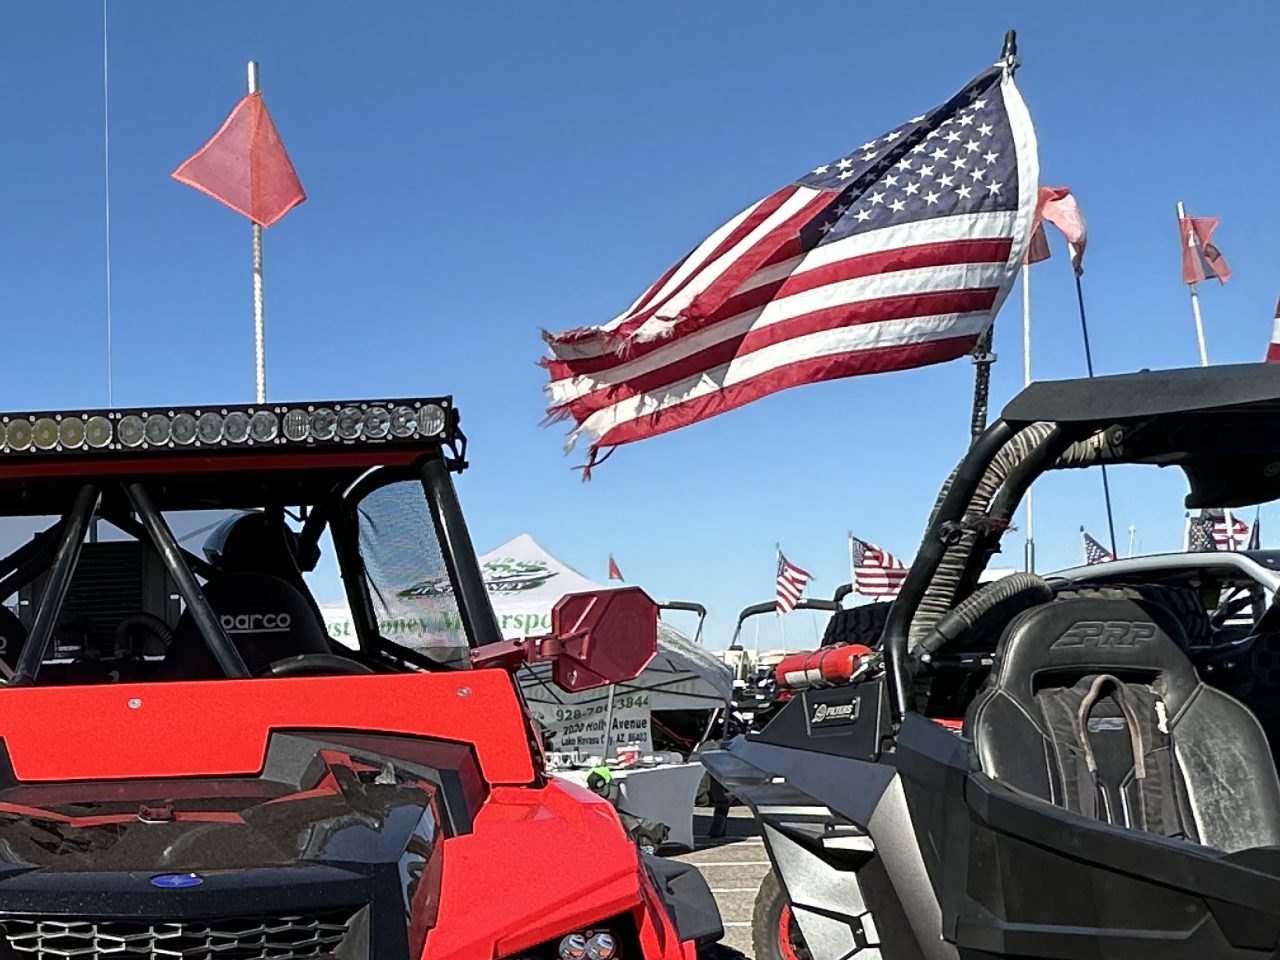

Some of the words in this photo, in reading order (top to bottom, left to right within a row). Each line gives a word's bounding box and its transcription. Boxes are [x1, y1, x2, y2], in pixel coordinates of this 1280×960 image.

[220, 613, 291, 631] parco
[1049, 620, 1159, 650] PRP
[612, 718, 648, 730] Avenue
